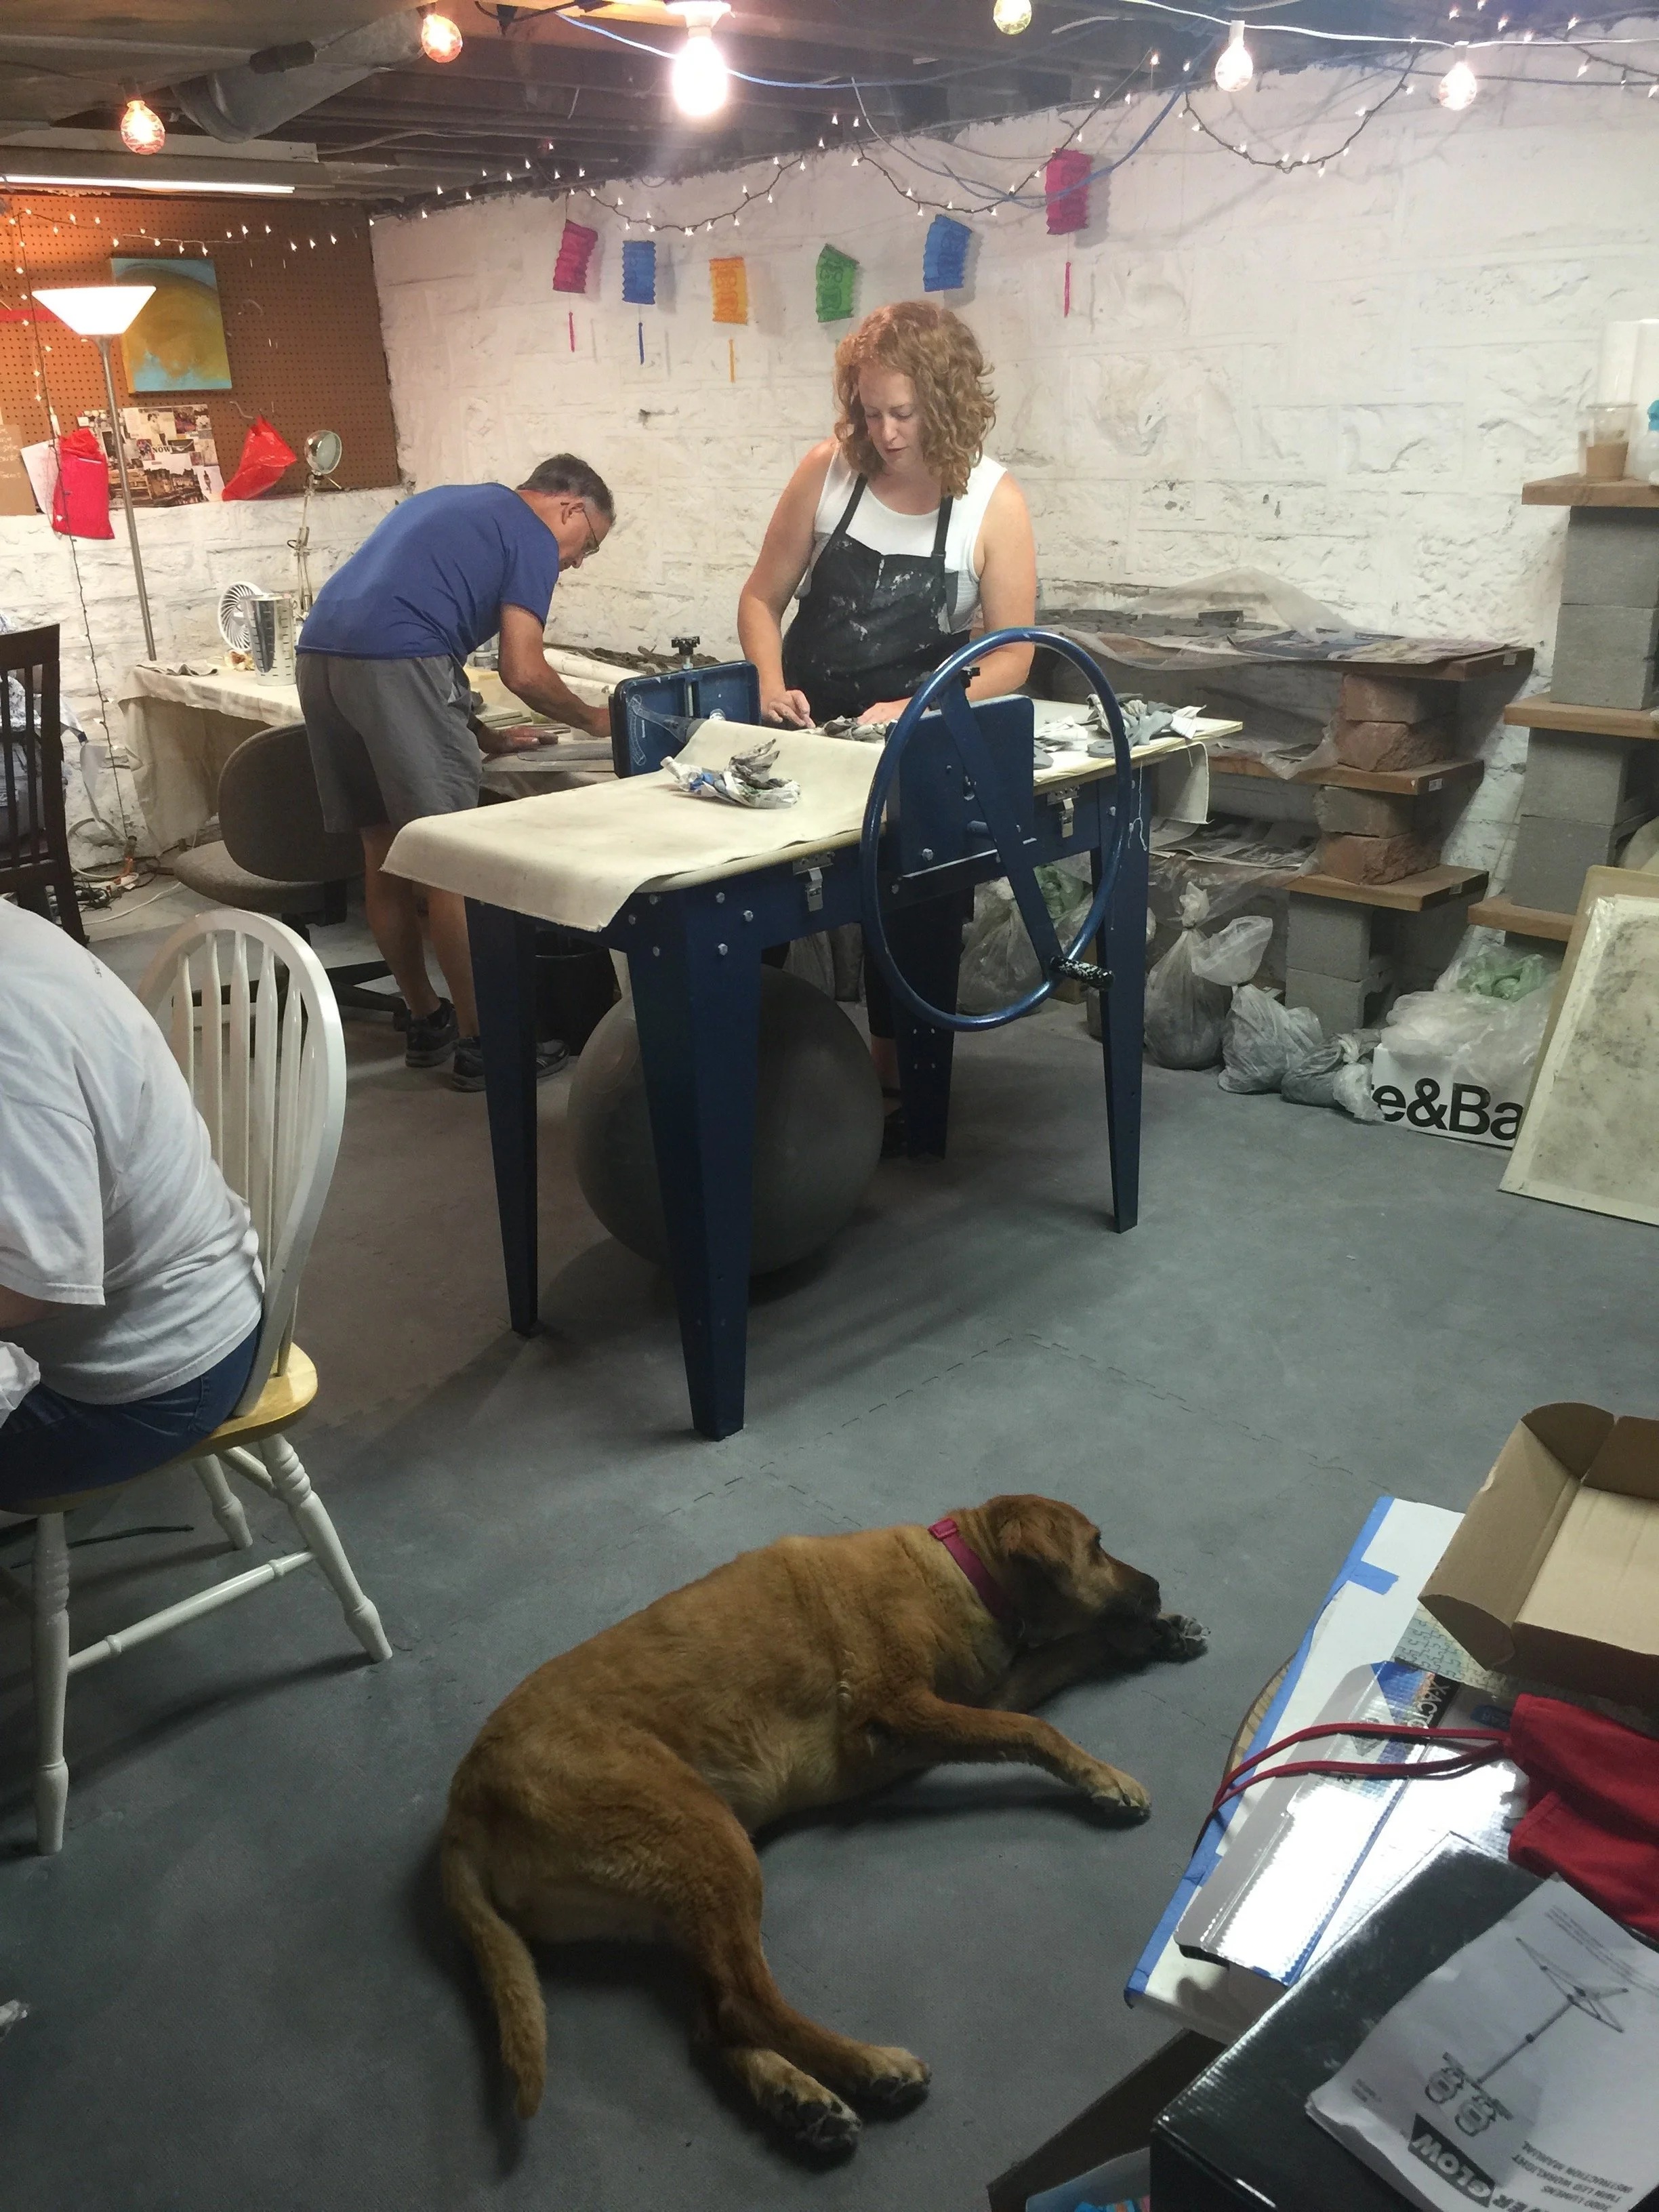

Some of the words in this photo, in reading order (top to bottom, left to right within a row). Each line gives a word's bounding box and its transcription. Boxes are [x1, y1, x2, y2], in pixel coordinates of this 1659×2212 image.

[152, 445, 170, 454] NOW
[1372, 1078, 1523, 1141] e&Ba
[1412, 2134, 1492, 2198] GLOW
